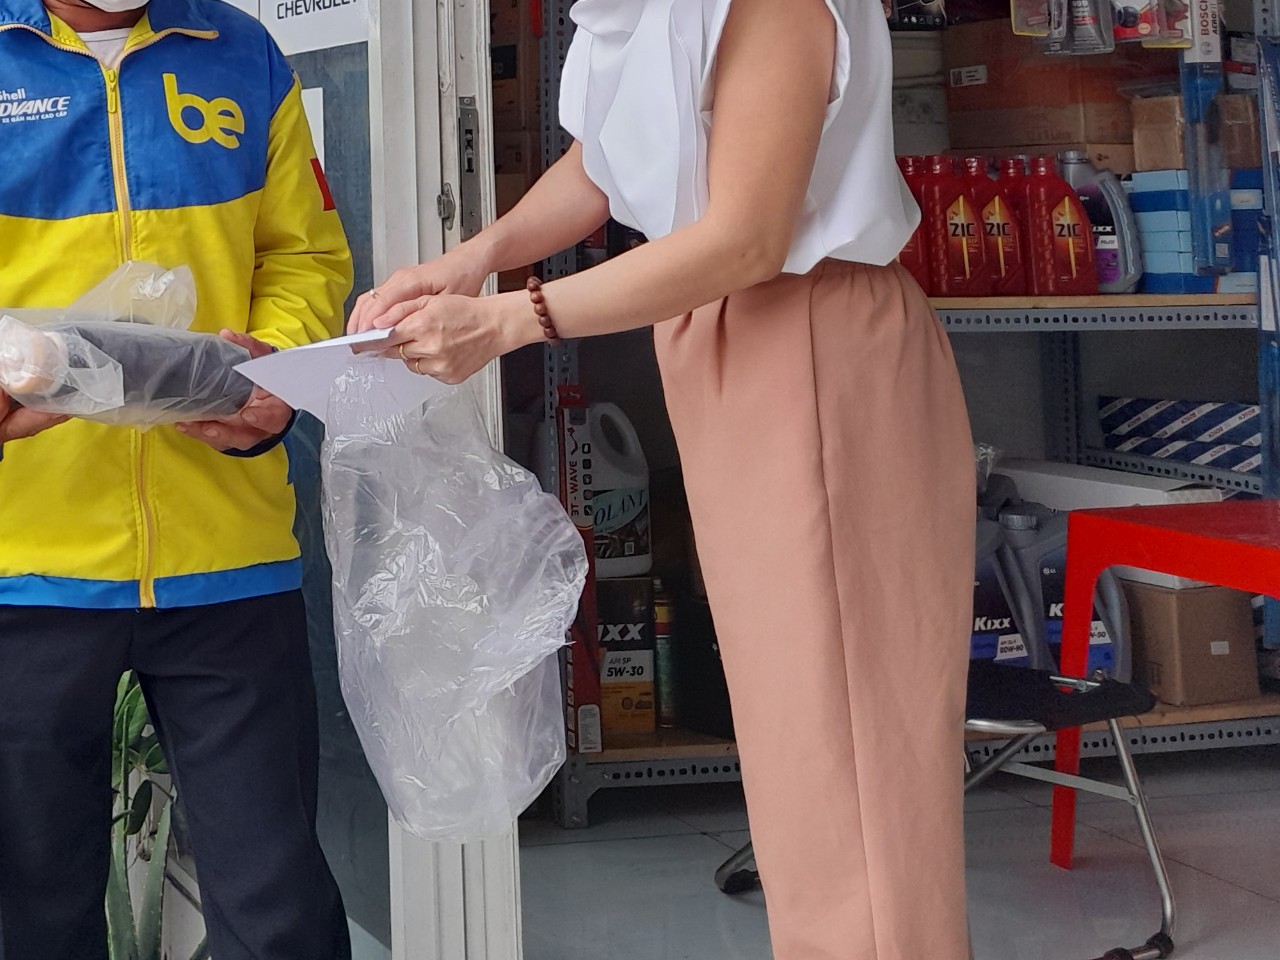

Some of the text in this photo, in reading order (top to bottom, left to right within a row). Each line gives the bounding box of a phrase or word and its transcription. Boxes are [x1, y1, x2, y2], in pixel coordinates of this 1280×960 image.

[161, 72, 246, 149] be
[949, 222, 976, 237] ZIC
[985, 222, 1011, 237] ZIC
[1055, 223, 1081, 237] ZIC
[569, 461, 578, 494] WAVE
[974, 616, 1011, 631] Kixx
[596, 622, 646, 641] ixx
[606, 666, 644, 677] 5W-30
